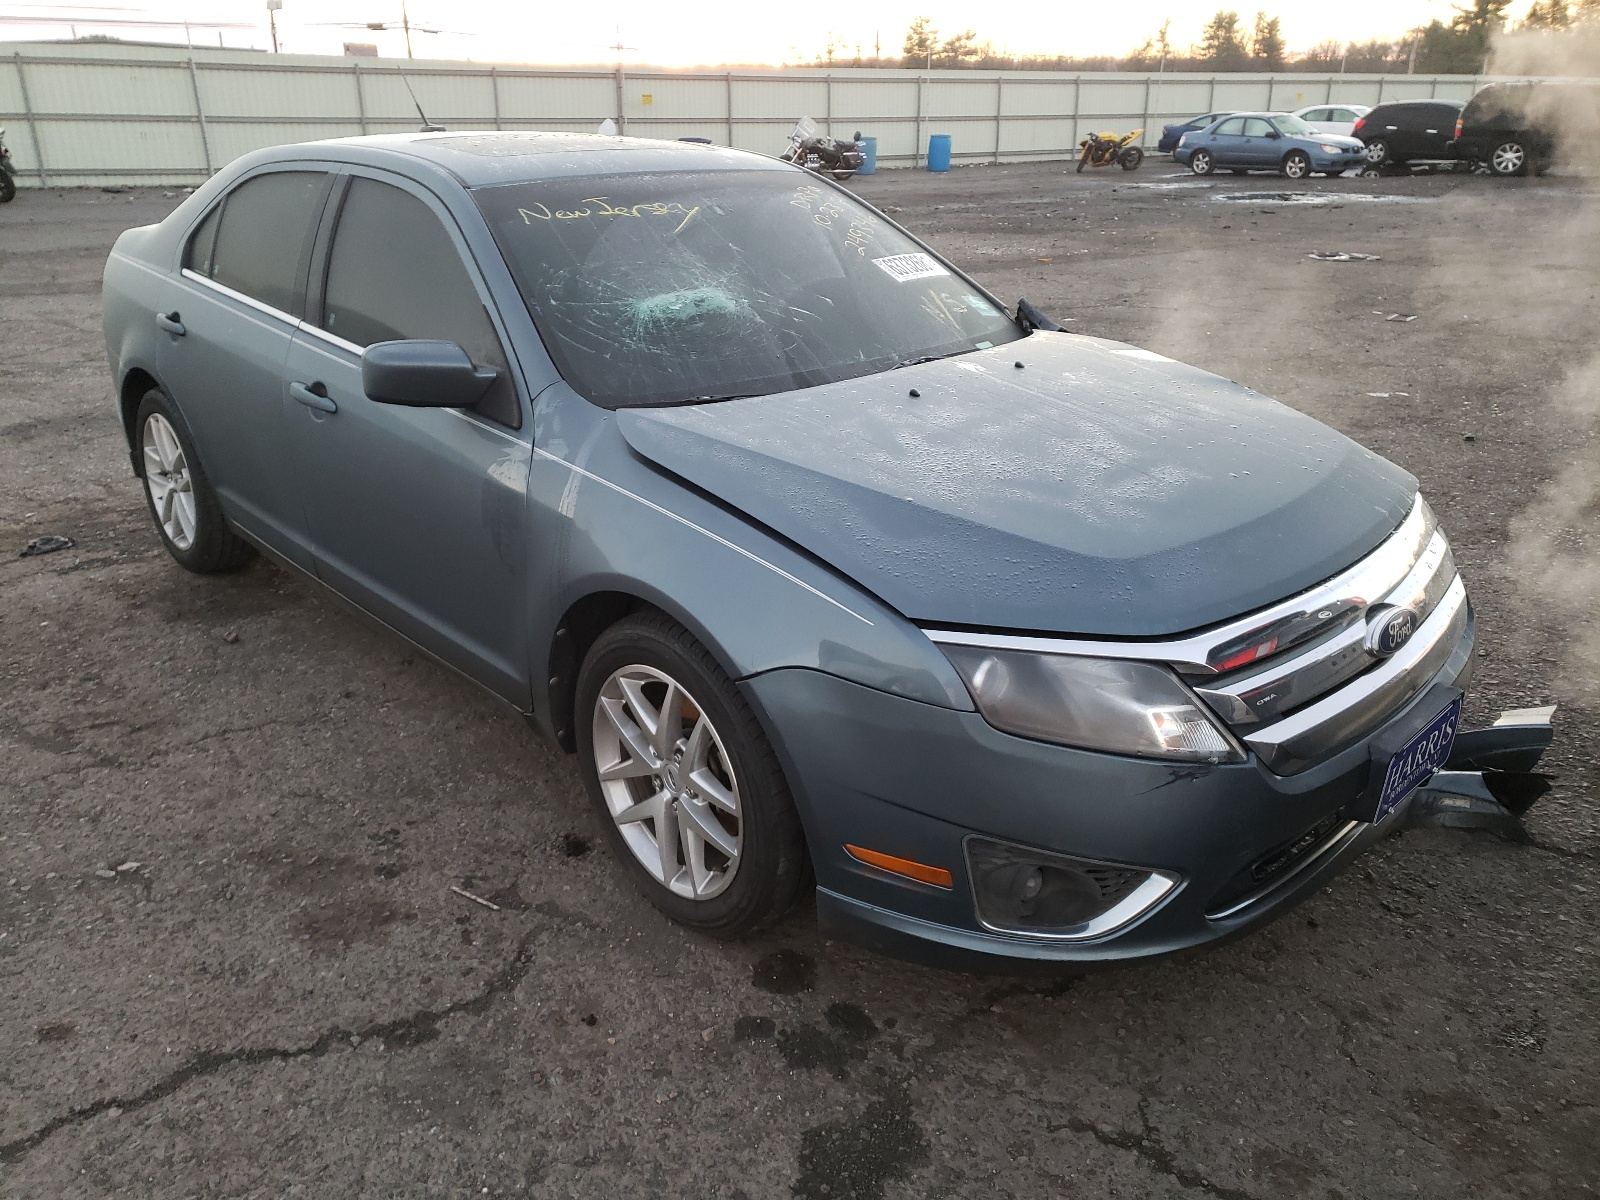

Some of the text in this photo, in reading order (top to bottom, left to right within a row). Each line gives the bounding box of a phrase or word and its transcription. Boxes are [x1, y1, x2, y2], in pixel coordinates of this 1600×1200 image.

[517, 201, 591, 225] New
[1388, 615, 1412, 648] Ford
[1385, 714, 1456, 796] HARRIS
